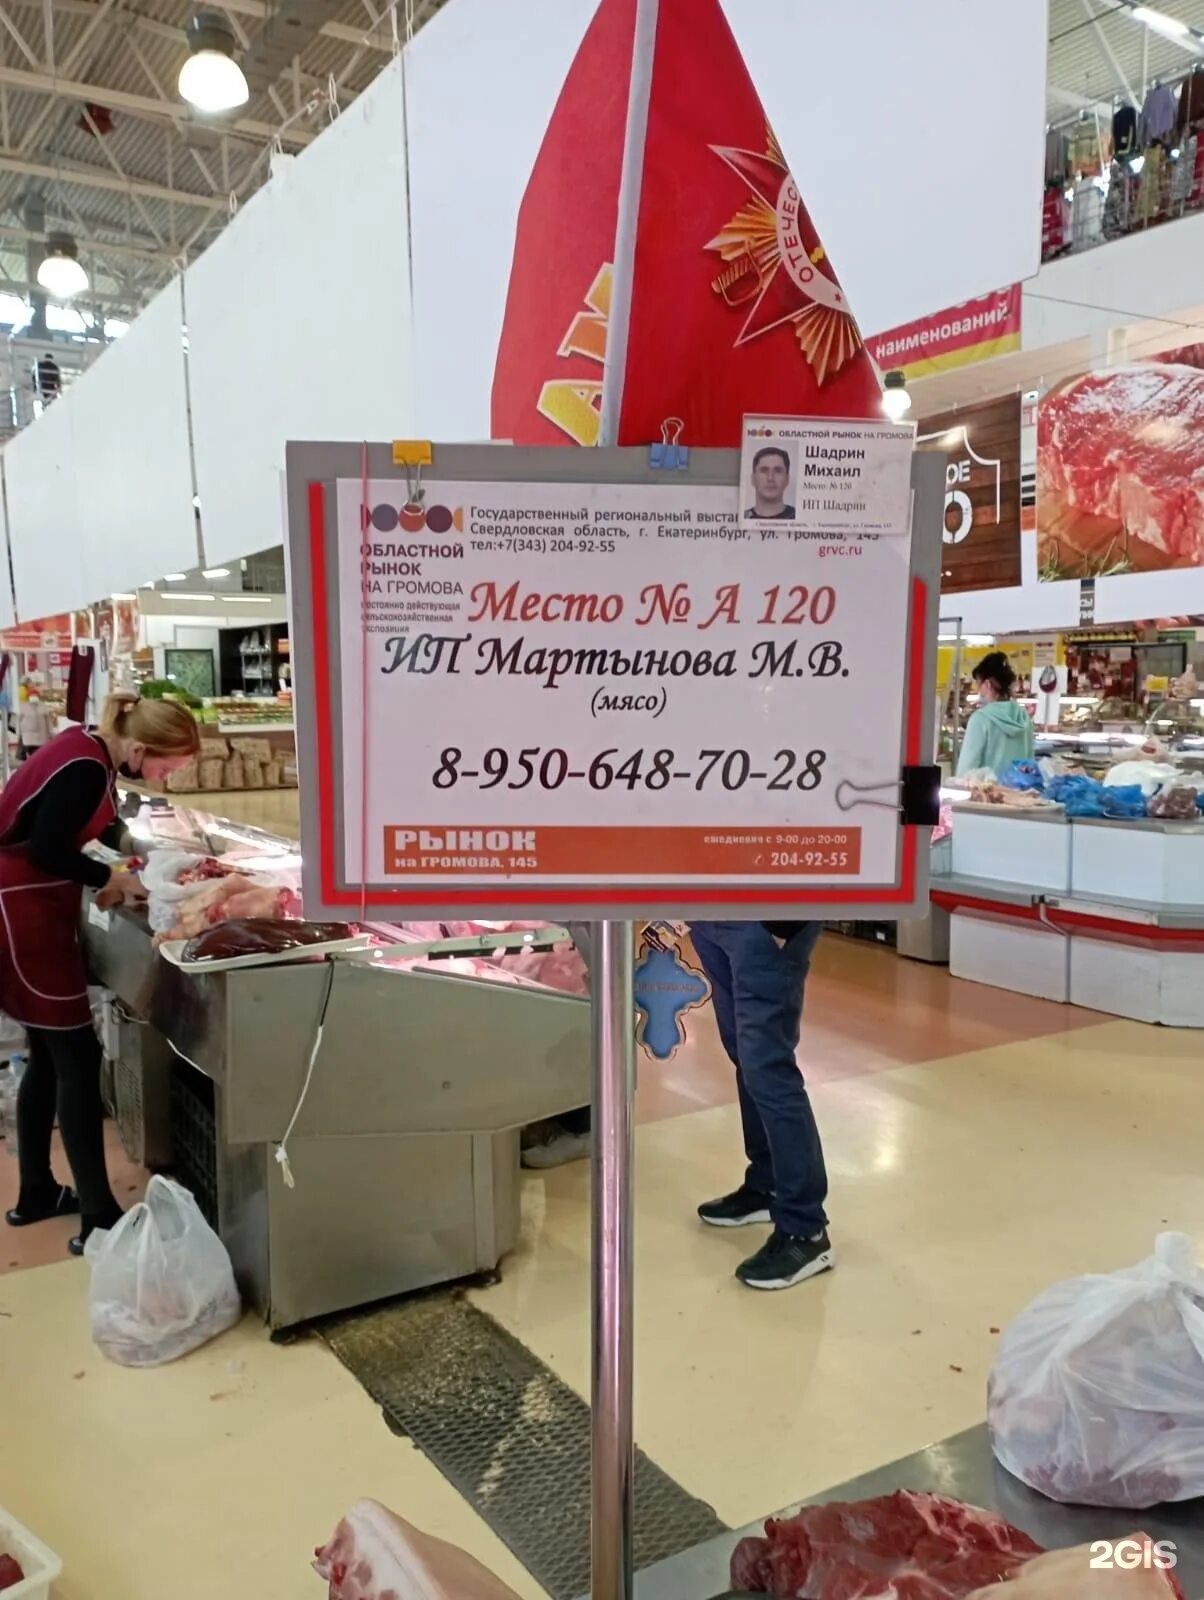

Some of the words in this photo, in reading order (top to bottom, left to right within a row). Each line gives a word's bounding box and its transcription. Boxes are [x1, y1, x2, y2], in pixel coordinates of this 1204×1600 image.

[875, 301, 1009, 359] наименований
[778, 430, 830, 438] ОБЛАСТНОЙ
[832, 431, 863, 439] РЫНОК
[877, 432, 914, 440] ГРОМОВА
[805, 445, 865, 461] Шадрин
[804, 464, 861, 478] Михаил
[823, 500, 866, 513] Шадрин
[470, 506, 588, 522] Государственный
[594, 509, 691, 524] региональный
[697, 512, 739, 523] выста
[470, 522, 565, 537] Свердловская
[574, 524, 630, 539] область,
[639, 527, 648, 537] г.
[657, 525, 752, 541] Екатеринбург,
[760, 530, 779, 540] ул.
[360, 542, 464, 559] ОБЛАСТНОЙ
[470, 538, 547, 554] тел:+7(343)
[550, 540, 616, 552] 204-92-55
[818, 544, 862, 557] grvc.ru
[360, 562, 422, 576] РЫНОК
[387, 580, 464, 595] ГРОМОВА
[406, 601, 460, 612] действующая
[467, 581, 624, 623] Место
[635, 583, 690, 626] №
[756, 585, 836, 625] 120
[381, 633, 472, 675] ИП
[475, 636, 737, 688] Мартынова
[748, 639, 850, 679] М.В.
[590, 686, 668, 718] (мясо)
[432, 746, 827, 792] 8-950-648-70-28
[394, 830, 536, 851] РЫНОК
[776, 834, 799, 845] 9-00
[801, 836, 815, 846] до
[818, 835, 847, 845] 20-00
[395, 858, 417, 868] на
[507, 857, 537, 868] 145
[771, 852, 849, 867] 204-92-55
